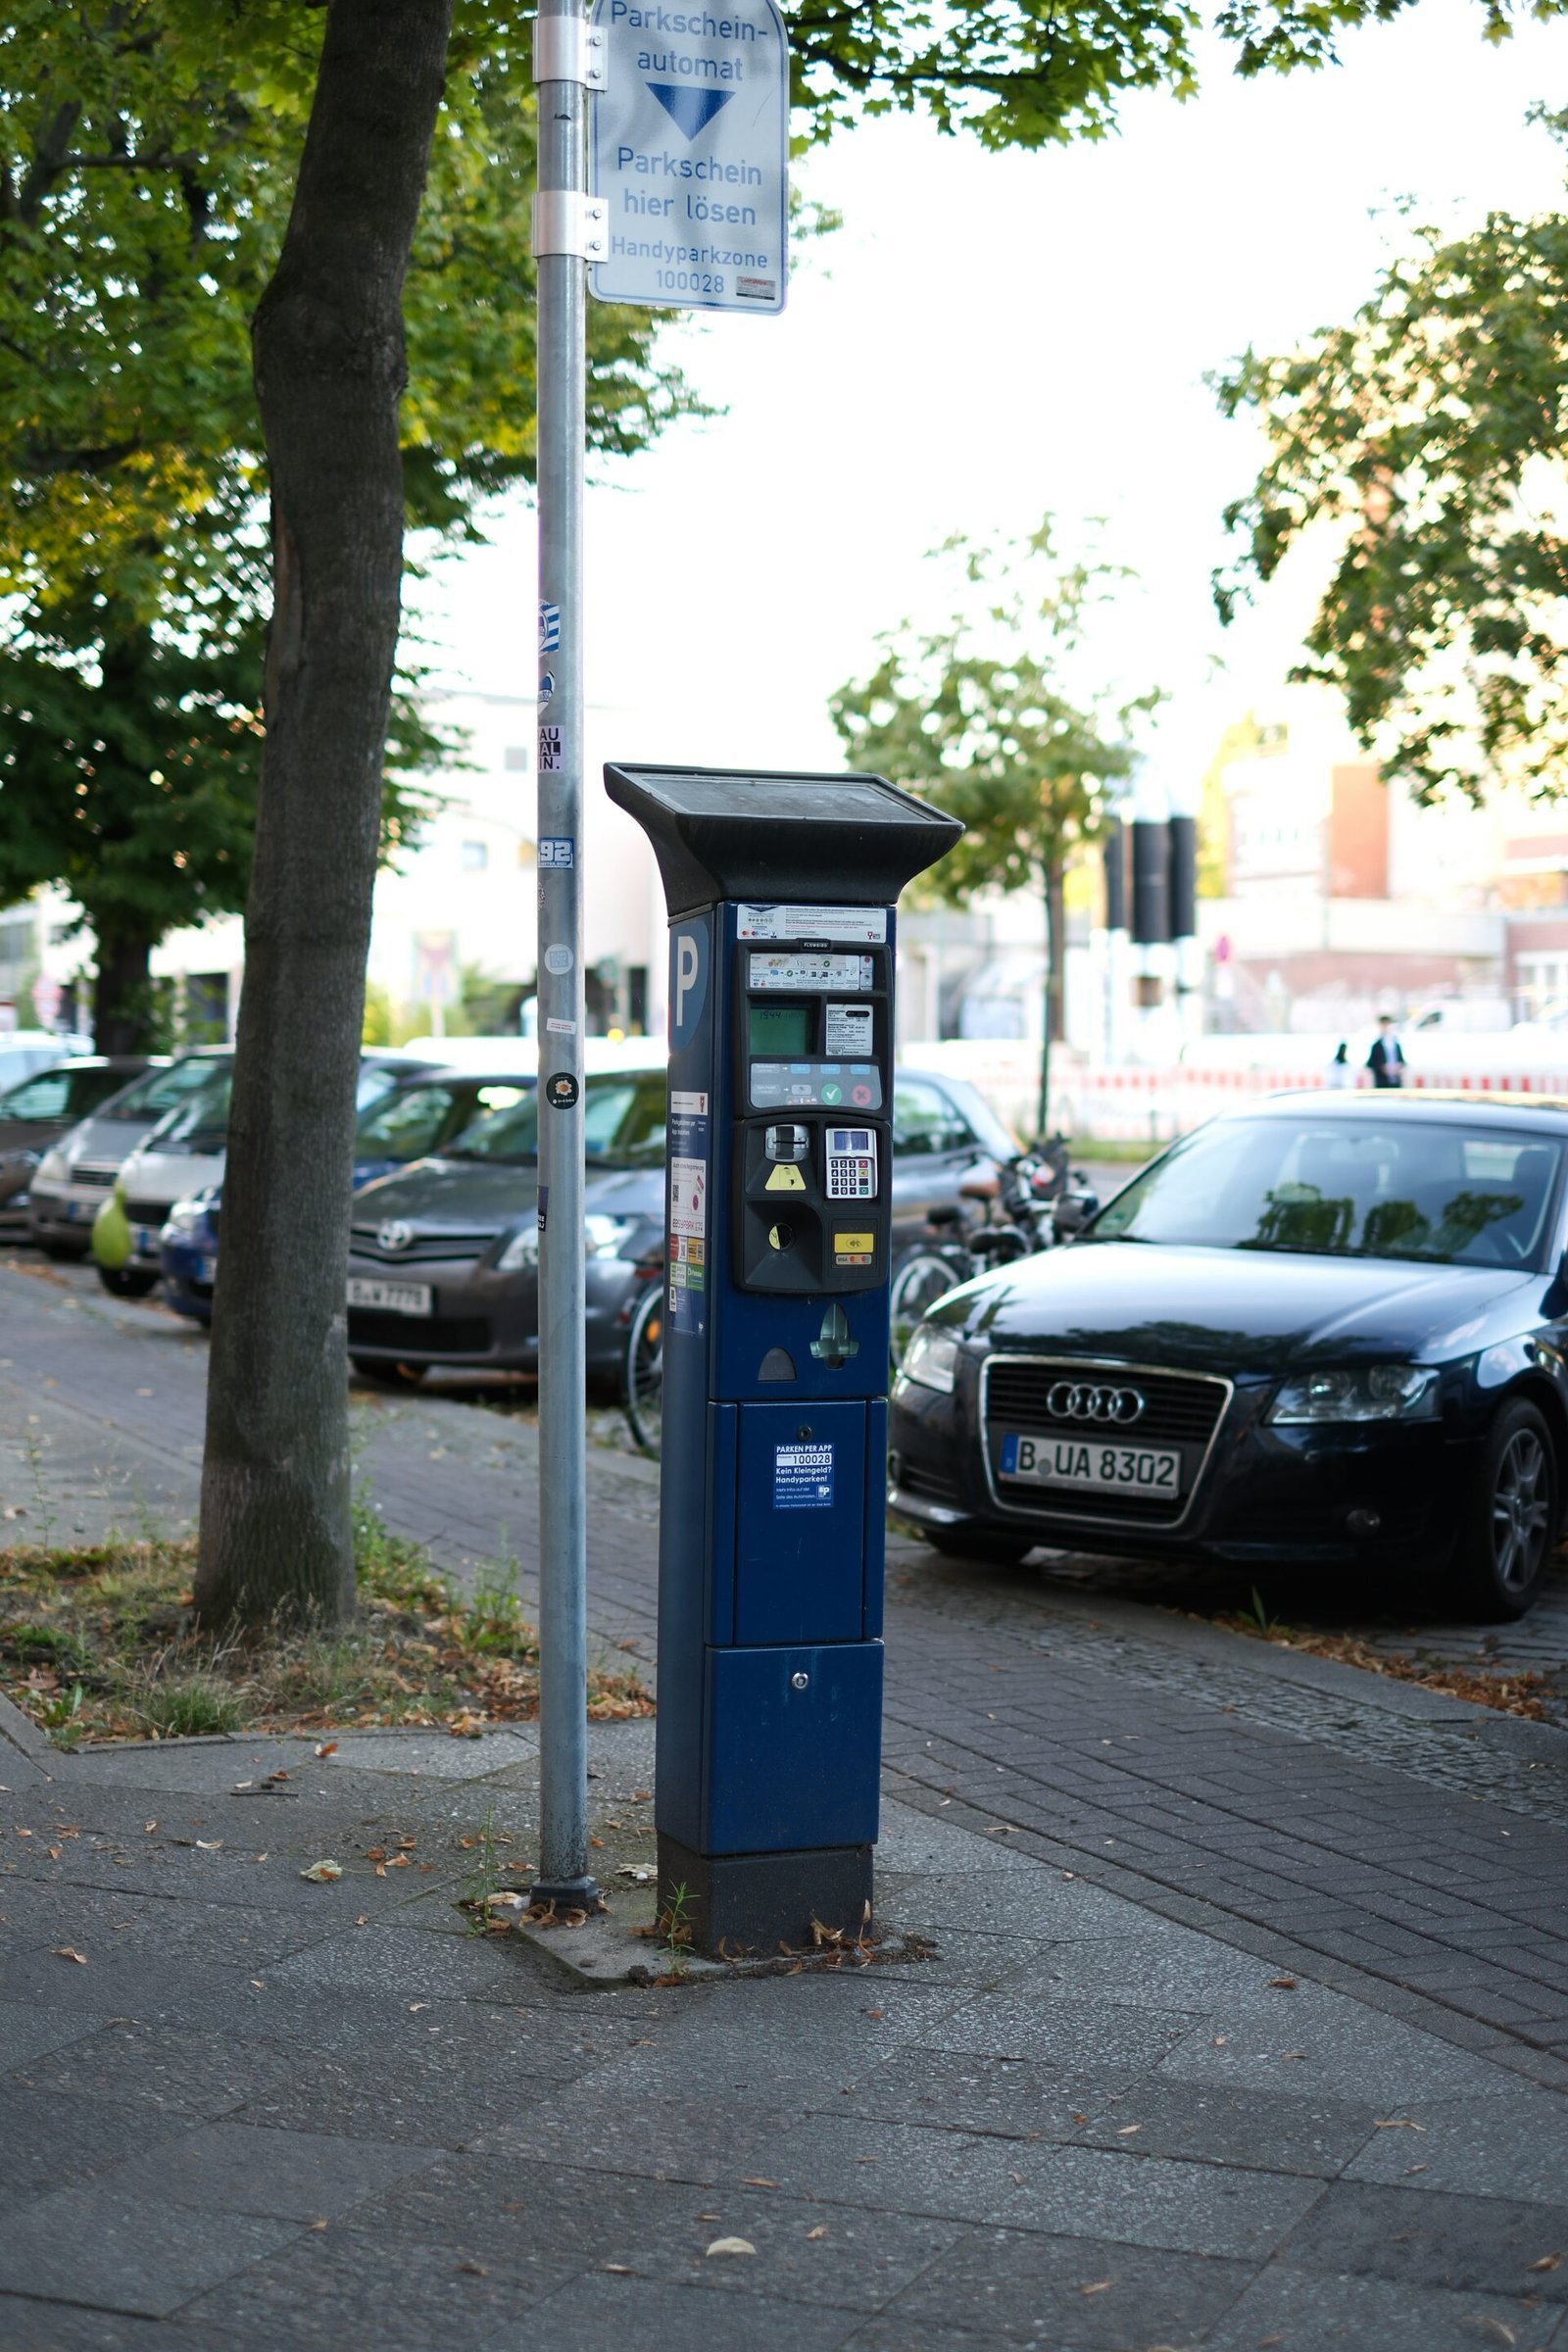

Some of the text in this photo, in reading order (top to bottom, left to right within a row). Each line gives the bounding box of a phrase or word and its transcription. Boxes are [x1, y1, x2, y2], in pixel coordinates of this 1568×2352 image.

[612, 1, 767, 41] Parkschein-
[637, 51, 744, 81] automat
[618, 147, 762, 186] Parkschein
[624, 189, 756, 225] hier lösen
[612, 236, 767, 269] Handyparkzone
[656, 270, 724, 294] 100028
[676, 936, 698, 1026] P
[794, 1454, 831, 1464] 100028
[1019, 1442, 1174, 1487] B UA 8302
